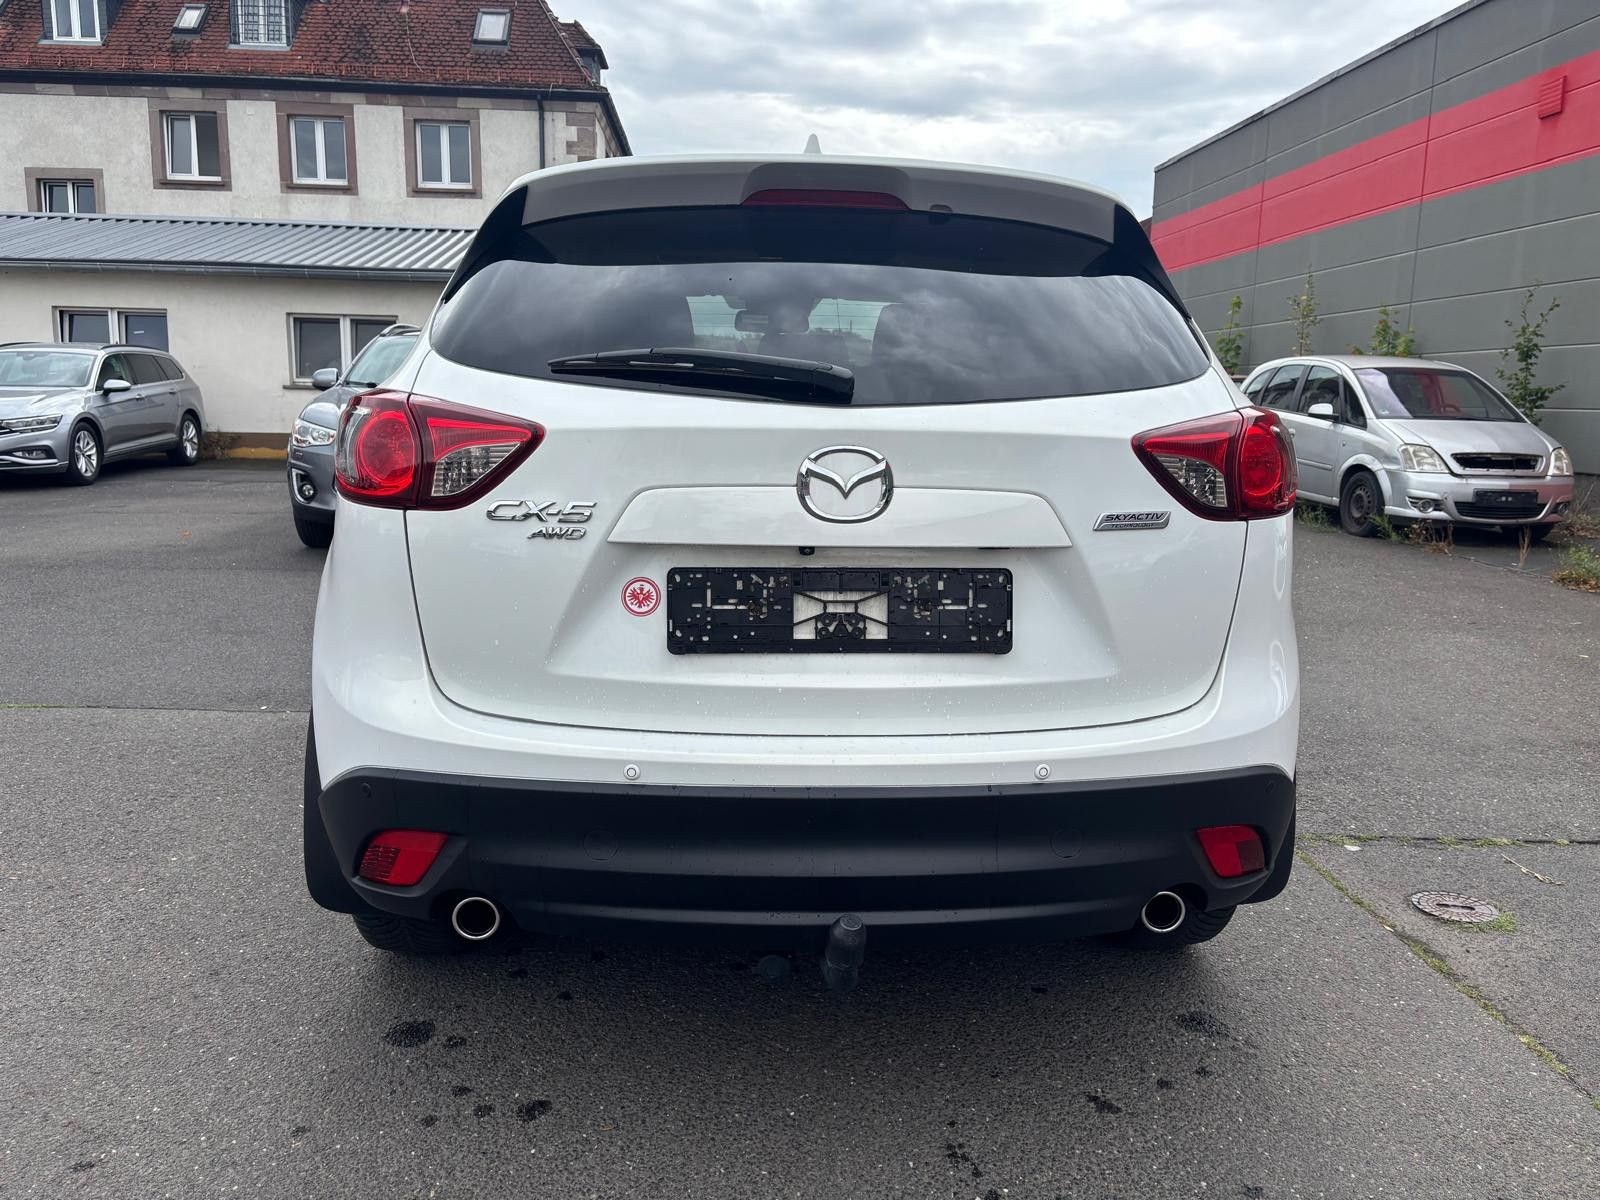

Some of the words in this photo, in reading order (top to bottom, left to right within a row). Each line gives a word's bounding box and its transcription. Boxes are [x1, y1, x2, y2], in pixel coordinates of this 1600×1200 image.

[486, 500, 598, 523] CX-5
[1105, 513, 1164, 521] SKYACTIV
[527, 526, 587, 540] AWD
